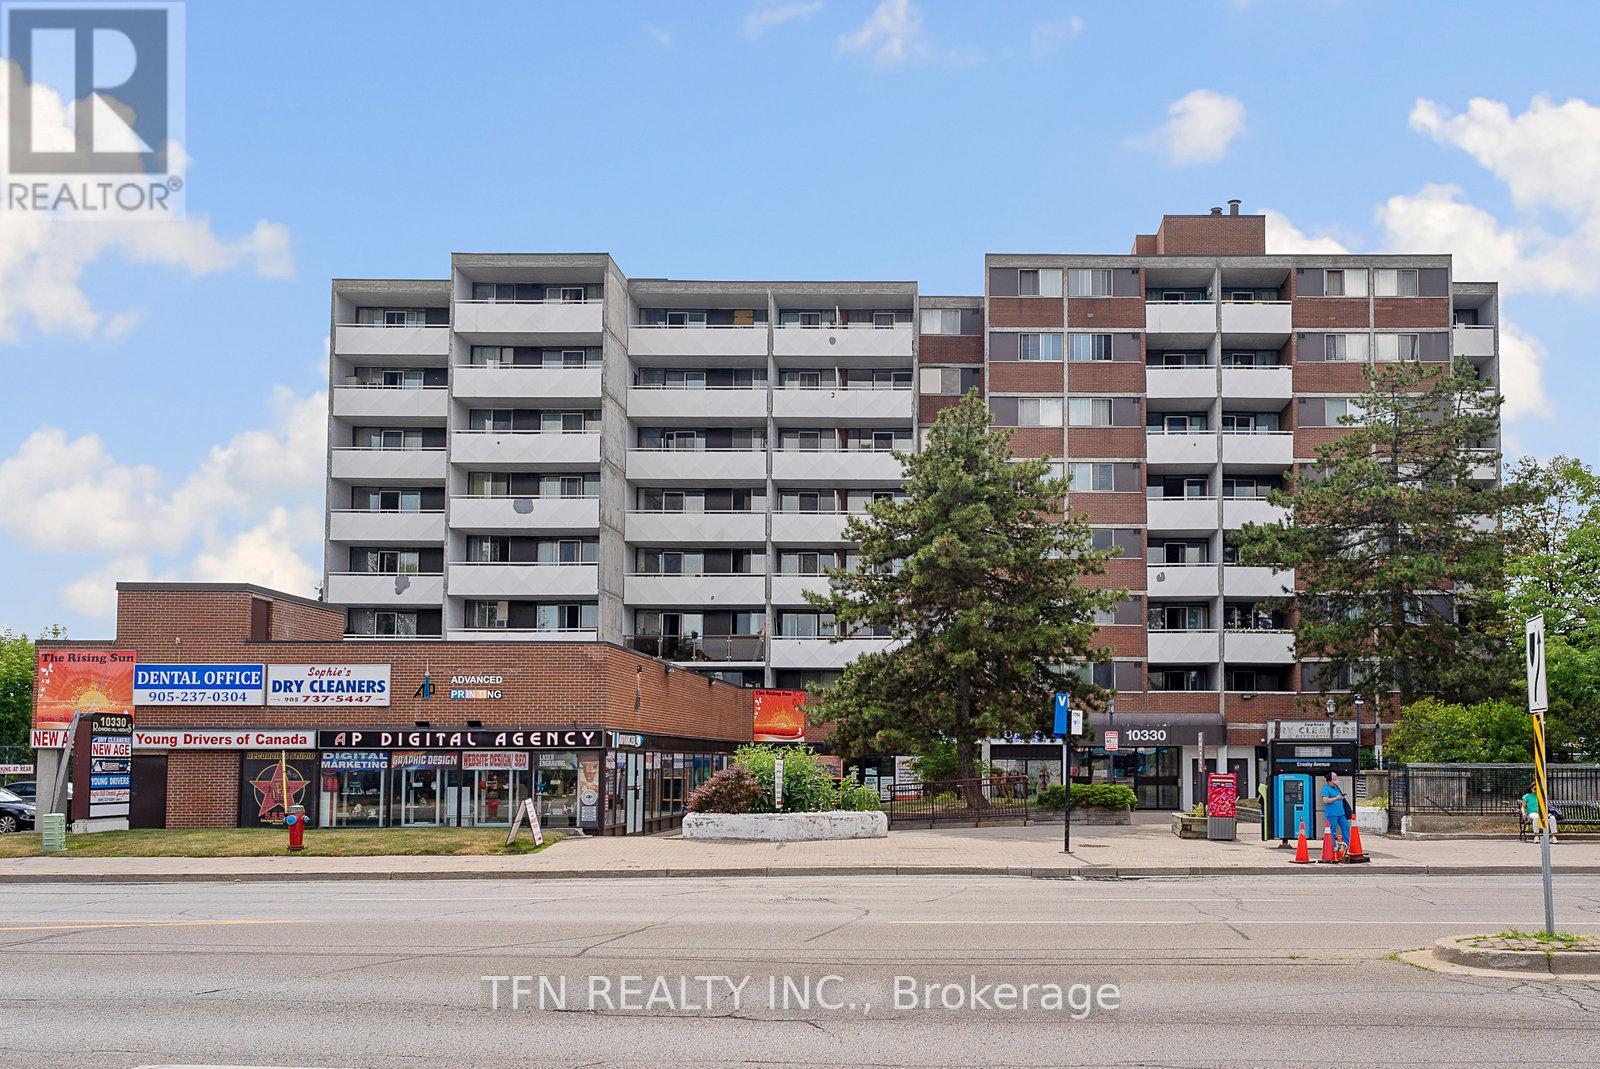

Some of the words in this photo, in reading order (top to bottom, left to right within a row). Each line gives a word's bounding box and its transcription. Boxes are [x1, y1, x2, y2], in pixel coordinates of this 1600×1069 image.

[41, 653, 64, 663] The
[67, 653, 107, 664] Rising
[109, 653, 134, 663] Sun
[137, 671, 201, 685] DENTAL
[204, 671, 261, 685] OFFICE
[450, 675, 503, 684] ADVANCED
[272, 680, 305, 693] DRY
[309, 680, 386, 693] CLEANERS
[148, 691, 248, 702] 905-237-0304
[302, 695, 372, 703] 737-5447
[450, 690, 503, 699] PRINTING
[100, 717, 127, 727] 10330
[34, 731, 59, 747] NEW
[136, 733, 178, 748] Young
[183, 733, 232, 745] Drivers
[236, 733, 250, 745] of
[255, 733, 308, 745] Canada
[334, 732, 362, 746] AP
[381, 732, 476, 746] DIGITAL
[495, 731, 595, 746] AGENCY
[1125, 729, 1167, 741] 10330
[92, 744, 112, 755] NEW
[113, 744, 130, 755] AGE
[322, 752, 389, 760] DIGITAL
[392, 755, 427, 766] GRAPHIC
[428, 755, 458, 765] DESIGN
[463, 753, 489, 767] WEBSITE
[514, 753, 527, 768] SEO
[321, 761, 389, 769] MARKETING
[91, 777, 108, 786] YOUNG
[109, 776, 130, 785] DRIVERS
